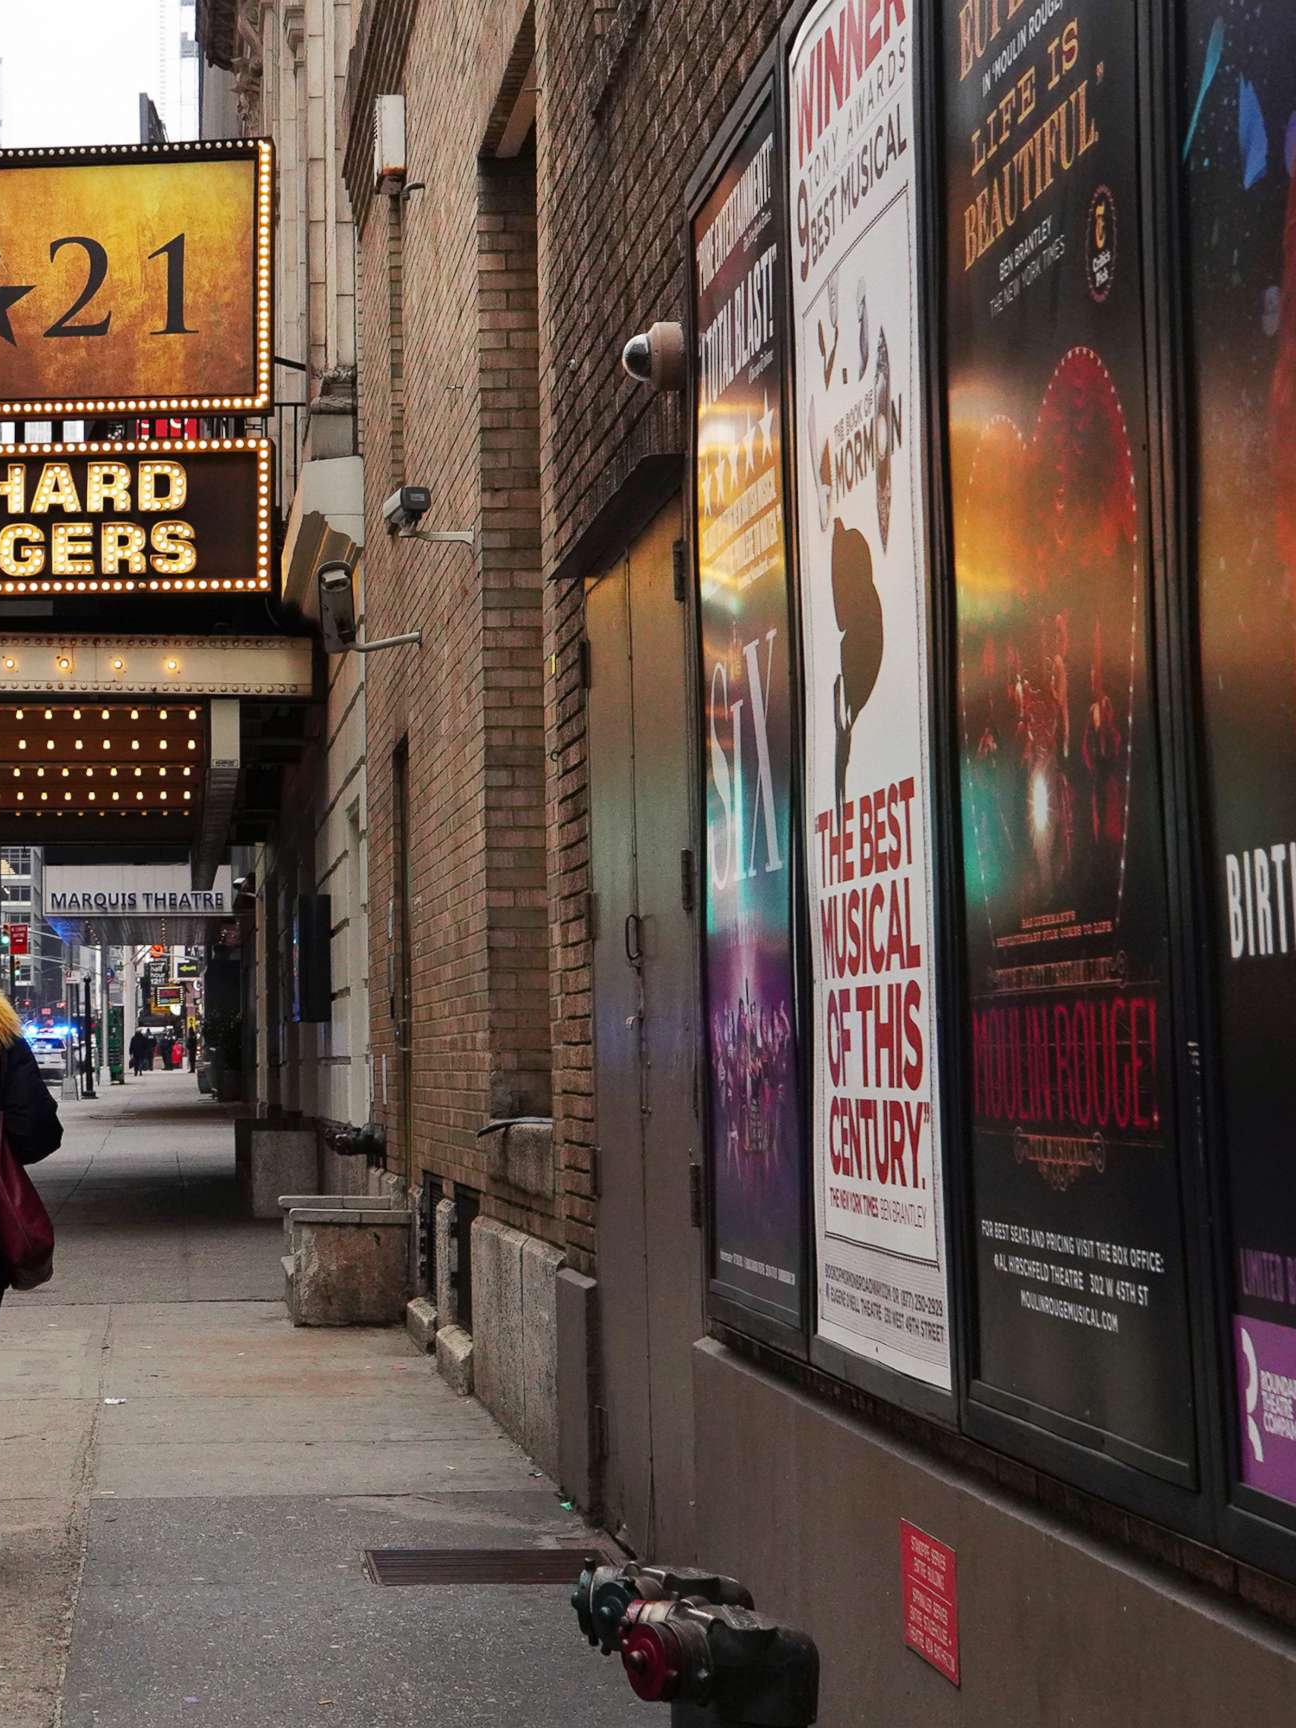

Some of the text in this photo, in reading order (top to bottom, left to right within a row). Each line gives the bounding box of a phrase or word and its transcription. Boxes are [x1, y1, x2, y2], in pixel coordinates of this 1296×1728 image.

[808, 33, 907, 198] TONY AWARDS
[971, 65, 1036, 177] LIFE
[1047, 17, 1079, 90] IS
[797, 179, 810, 282] 9
[811, 184, 837, 267] BEST
[840, 103, 908, 225] MUSICAL
[835, 393, 902, 504] MORMON
[710, 627, 784, 891] SIX
[859, 776, 915, 878] BEST
[50, 892, 224, 911] MARQUIS THEATRE
[820, 877, 921, 980] MUSICAL
[827, 979, 923, 1091] OF THIS
[972, 996, 1159, 1131] MOULIN ROUGE!
[994, 1222, 1010, 1241] BEST
[1010, 1225, 1030, 1245] SEATS
[1030, 1229, 1045, 1249] AND
[1046, 1232, 1075, 1255] PRICING
[1075, 1237, 1096, 1259] VISIT
[1096, 1241, 1111, 1262] THE
[1112, 1244, 1130, 1266] BOX
[1050, 1264, 1084, 1291] THEATRE
[1089, 1273, 1105, 1295] 302
[1137, 1284, 1149, 1307] ST
